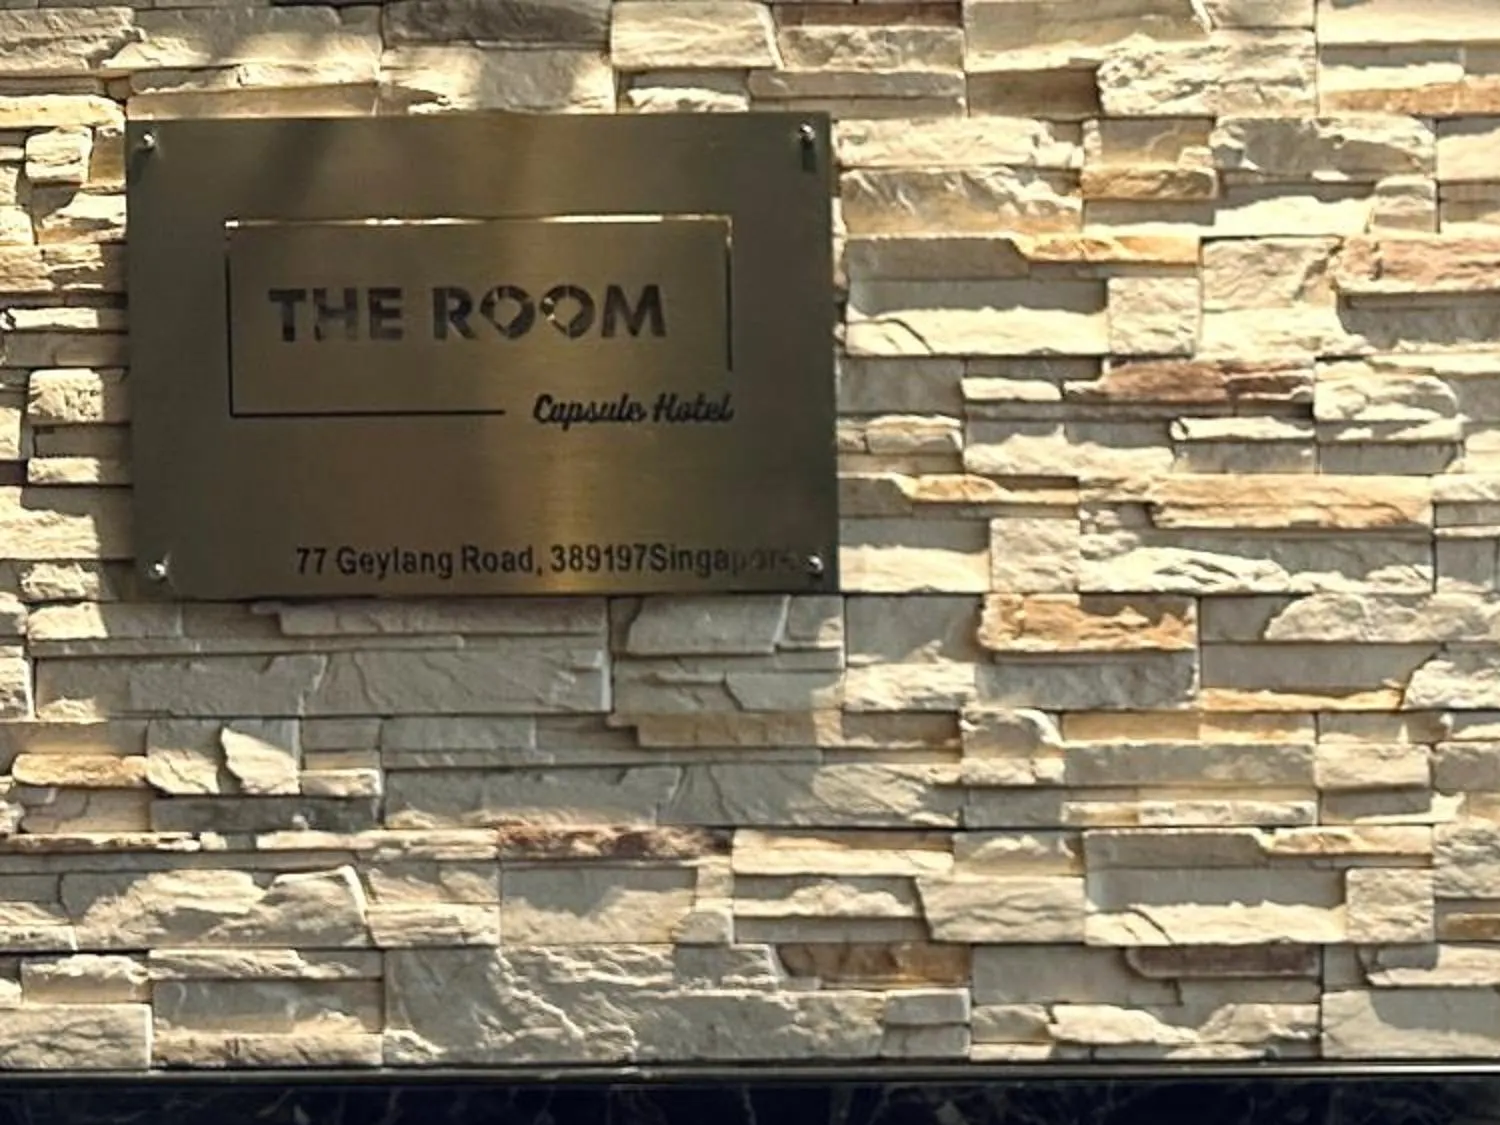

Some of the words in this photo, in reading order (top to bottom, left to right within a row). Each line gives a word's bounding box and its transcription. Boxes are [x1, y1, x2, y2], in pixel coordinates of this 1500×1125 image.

[268, 287, 404, 343] THE
[433, 284, 667, 342] ROOM
[532, 392, 648, 431] Capsule
[649, 392, 735, 423] Hotel
[296, 547, 328, 575] 77
[336, 545, 454, 580] Geylang
[460, 544, 544, 577] Road,
